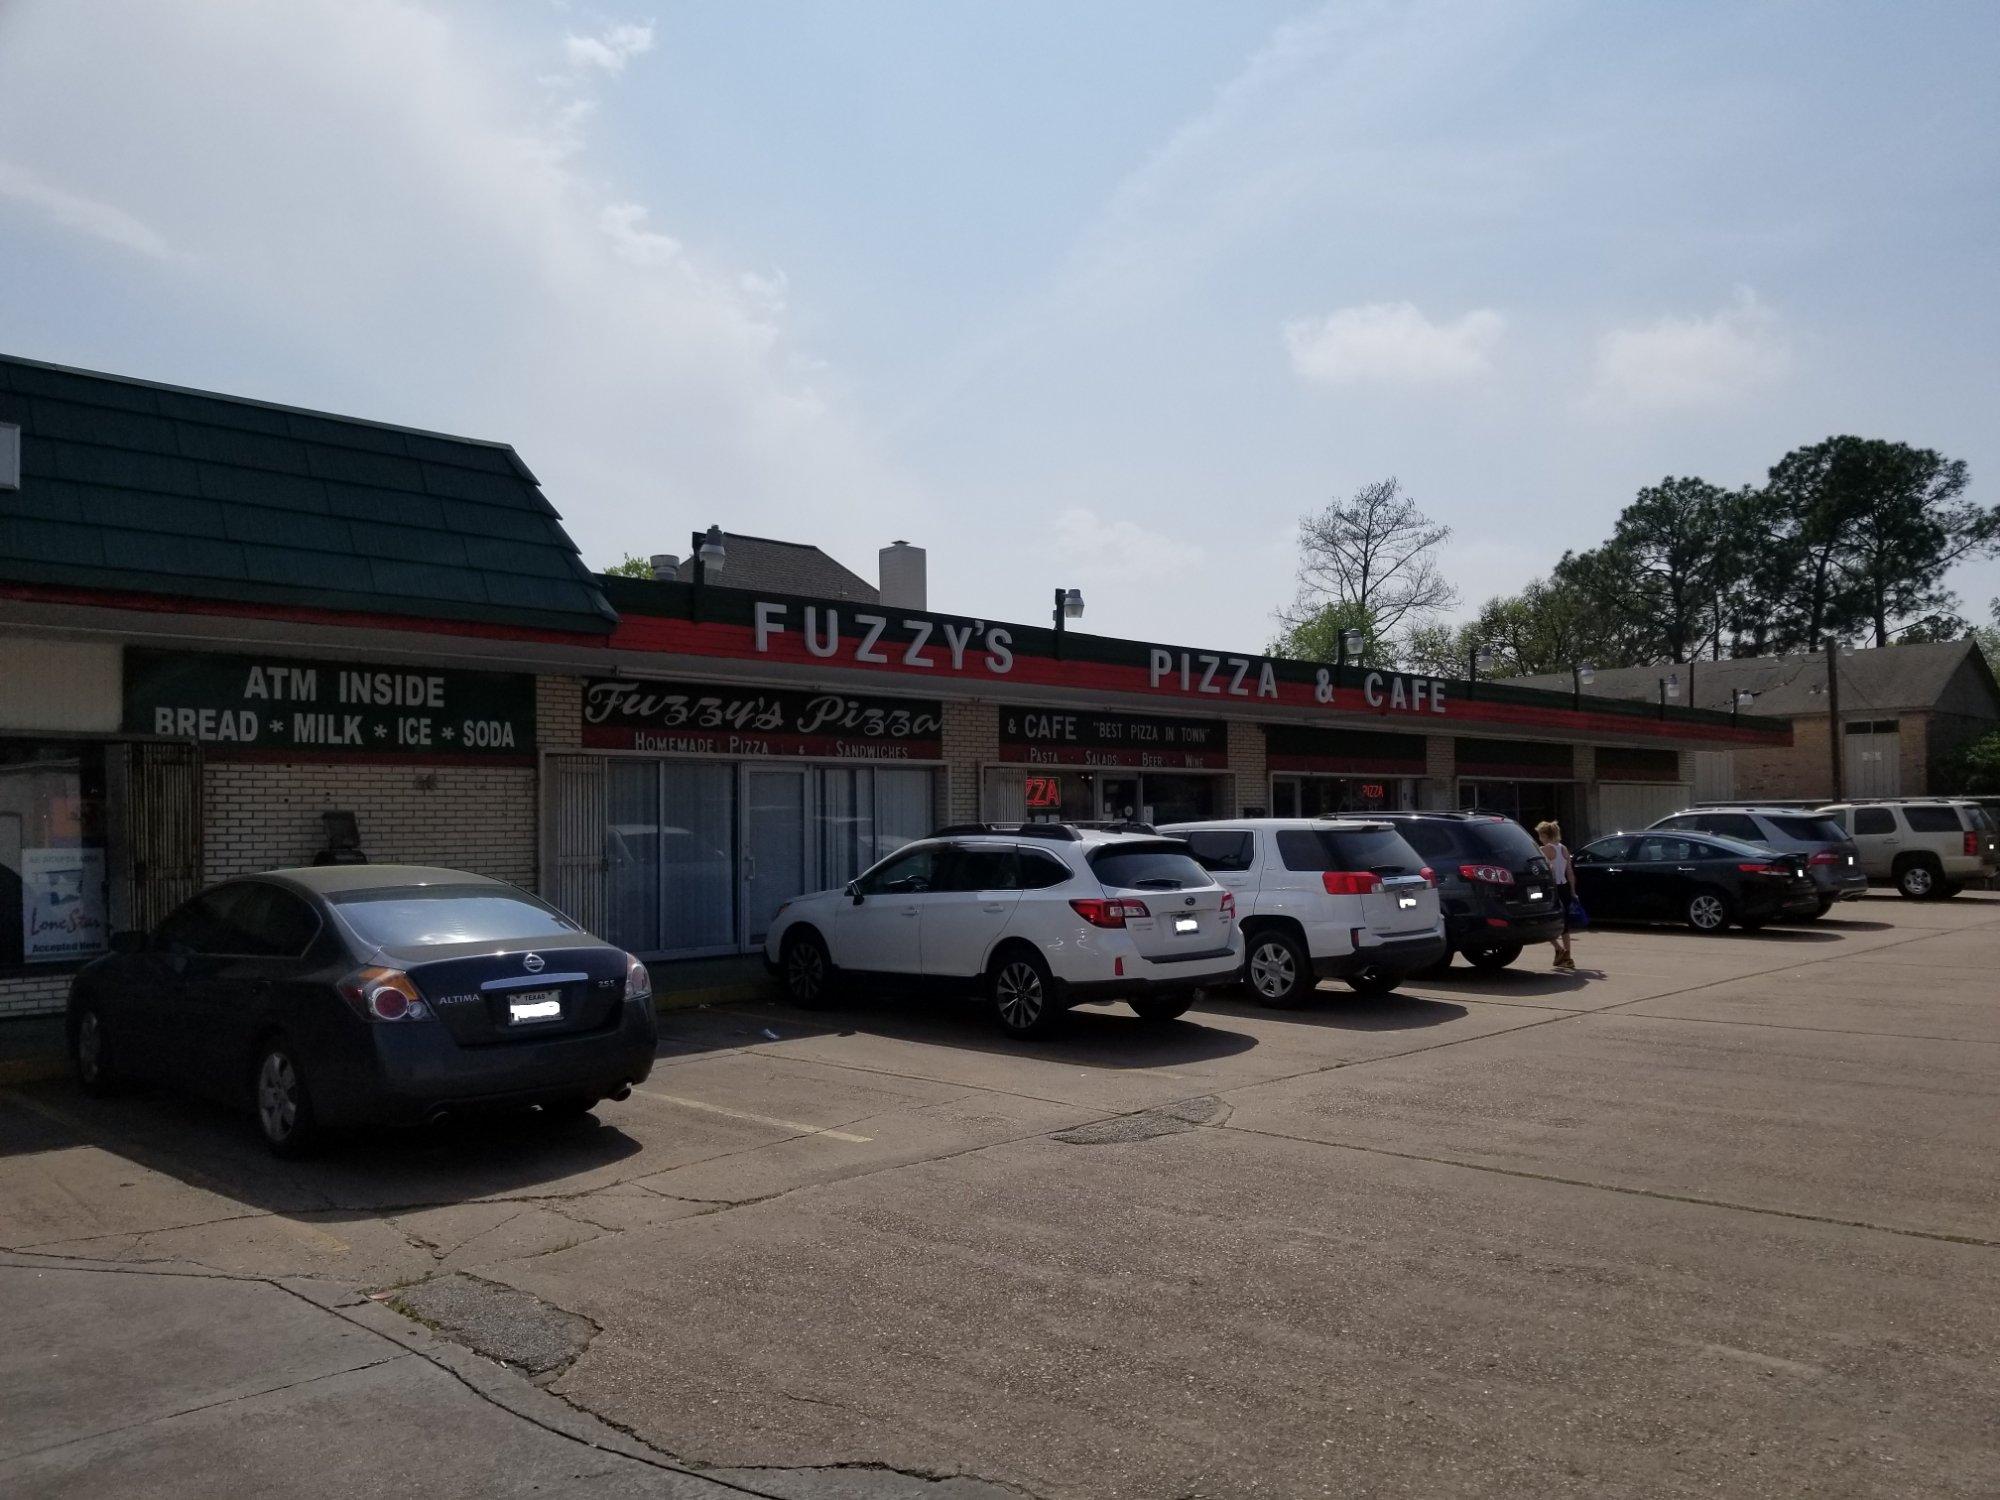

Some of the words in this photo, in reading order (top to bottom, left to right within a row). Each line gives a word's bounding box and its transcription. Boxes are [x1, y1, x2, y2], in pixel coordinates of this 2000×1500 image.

[754, 601, 1014, 674] FUZZY'S
[1150, 649, 1278, 699] PIZZA
[1314, 667, 1335, 704] &
[1363, 671, 1446, 714] CAFE
[243, 665, 317, 702] ATM
[338, 671, 446, 708] INSIDE
[584, 681, 785, 730] Fuzzy's
[796, 695, 943, 737] Pizza
[154, 706, 259, 743] BREAD
[293, 712, 364, 745] MILK
[397, 717, 433, 745] ICE
[462, 719, 516, 748] SODA
[1007, 717, 1017, 735] &
[1024, 713, 1078, 740] CAFE
[1130, 724, 1159, 741] PIZZA
[1165, 726, 1175, 741] IN
[729, 735, 769, 755] PIZZA
[1362, 783, 1384, 798] PIZZA
[439, 994, 480, 1004] ALTIMA
[523, 993, 546, 1001] TEXAS
